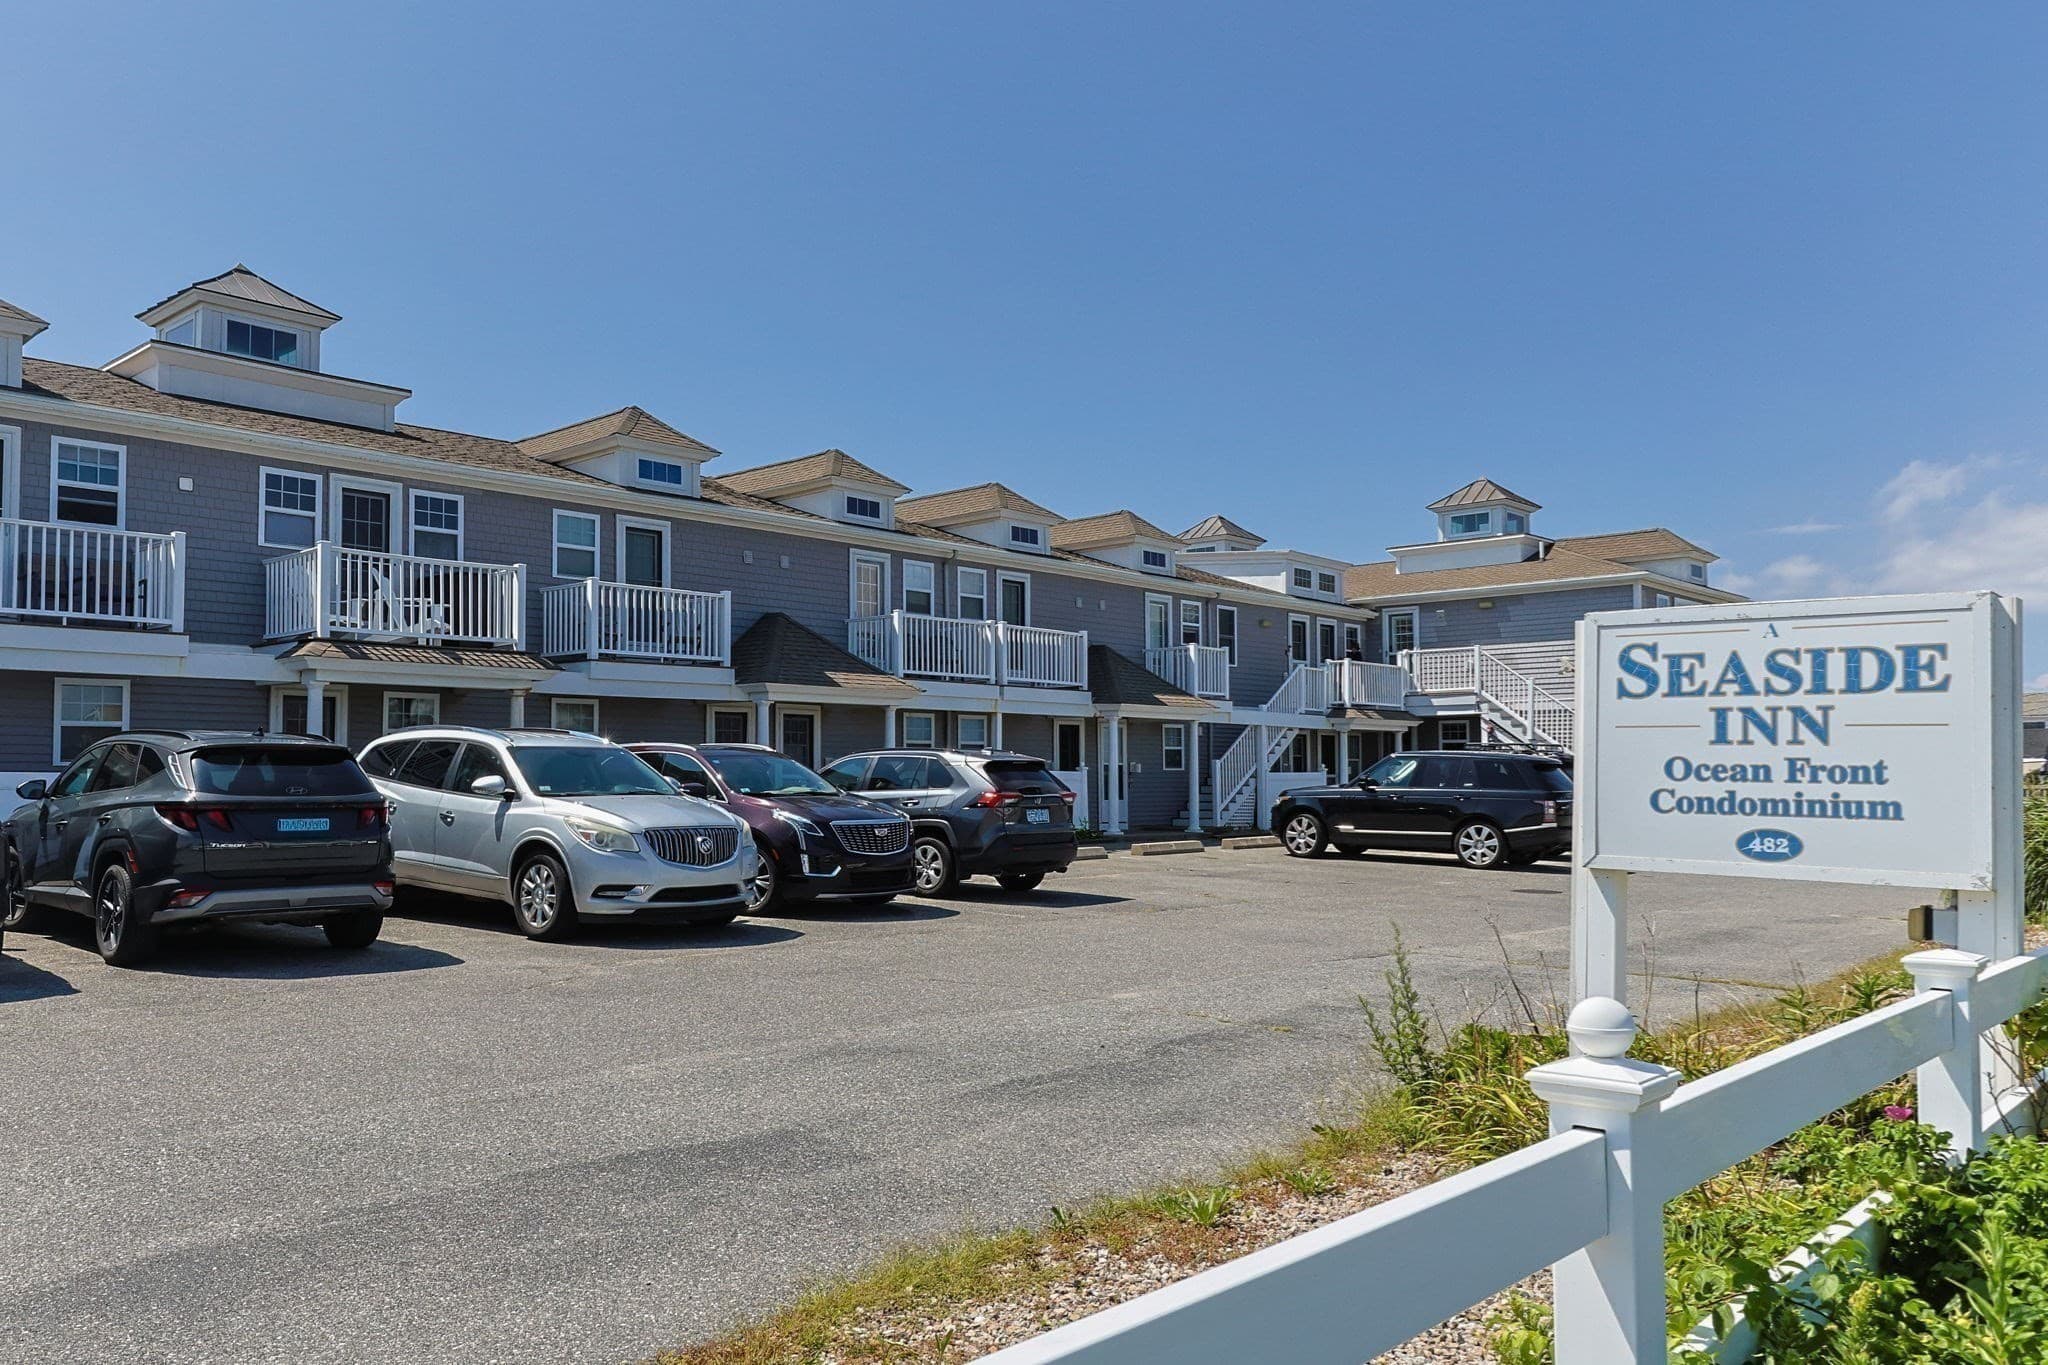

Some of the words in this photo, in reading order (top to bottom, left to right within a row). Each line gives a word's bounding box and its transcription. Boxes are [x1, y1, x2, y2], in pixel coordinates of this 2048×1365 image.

[1761, 622, 1779, 638] A
[1617, 643, 1951, 699] SEASIDE
[1708, 705, 1834, 746] INN
[1664, 756, 1773, 783] Ocean
[1783, 757, 1889, 785] Front
[1650, 789, 1904, 821] Condominium
[1748, 837, 1790, 853] 482
